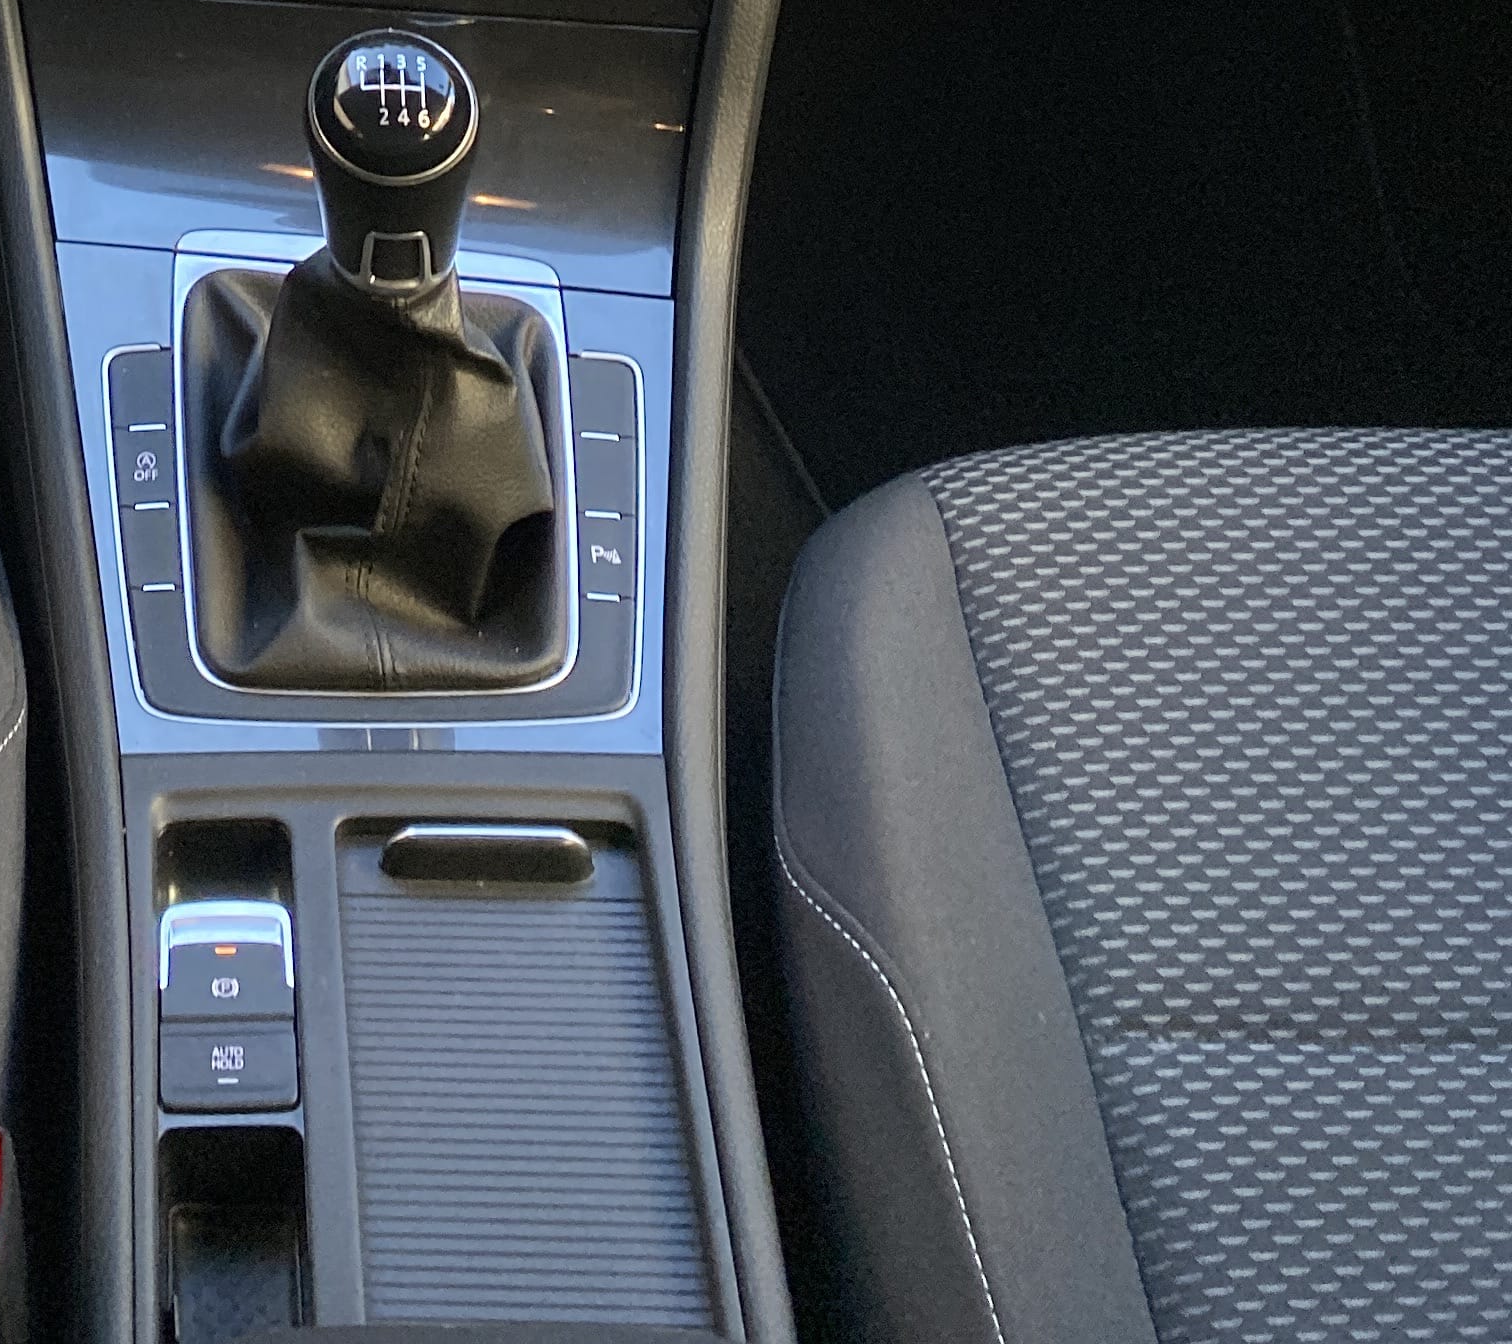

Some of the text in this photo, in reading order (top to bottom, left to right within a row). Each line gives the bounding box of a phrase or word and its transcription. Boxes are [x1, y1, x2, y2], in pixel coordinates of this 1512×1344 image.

[355, 53, 427, 72] R 1 3 5
[379, 107, 431, 129] 2 4 6
[133, 469, 158, 482] OFF
[211, 1045, 245, 1058] AUTO
[211, 1057, 245, 1071] HOLD
